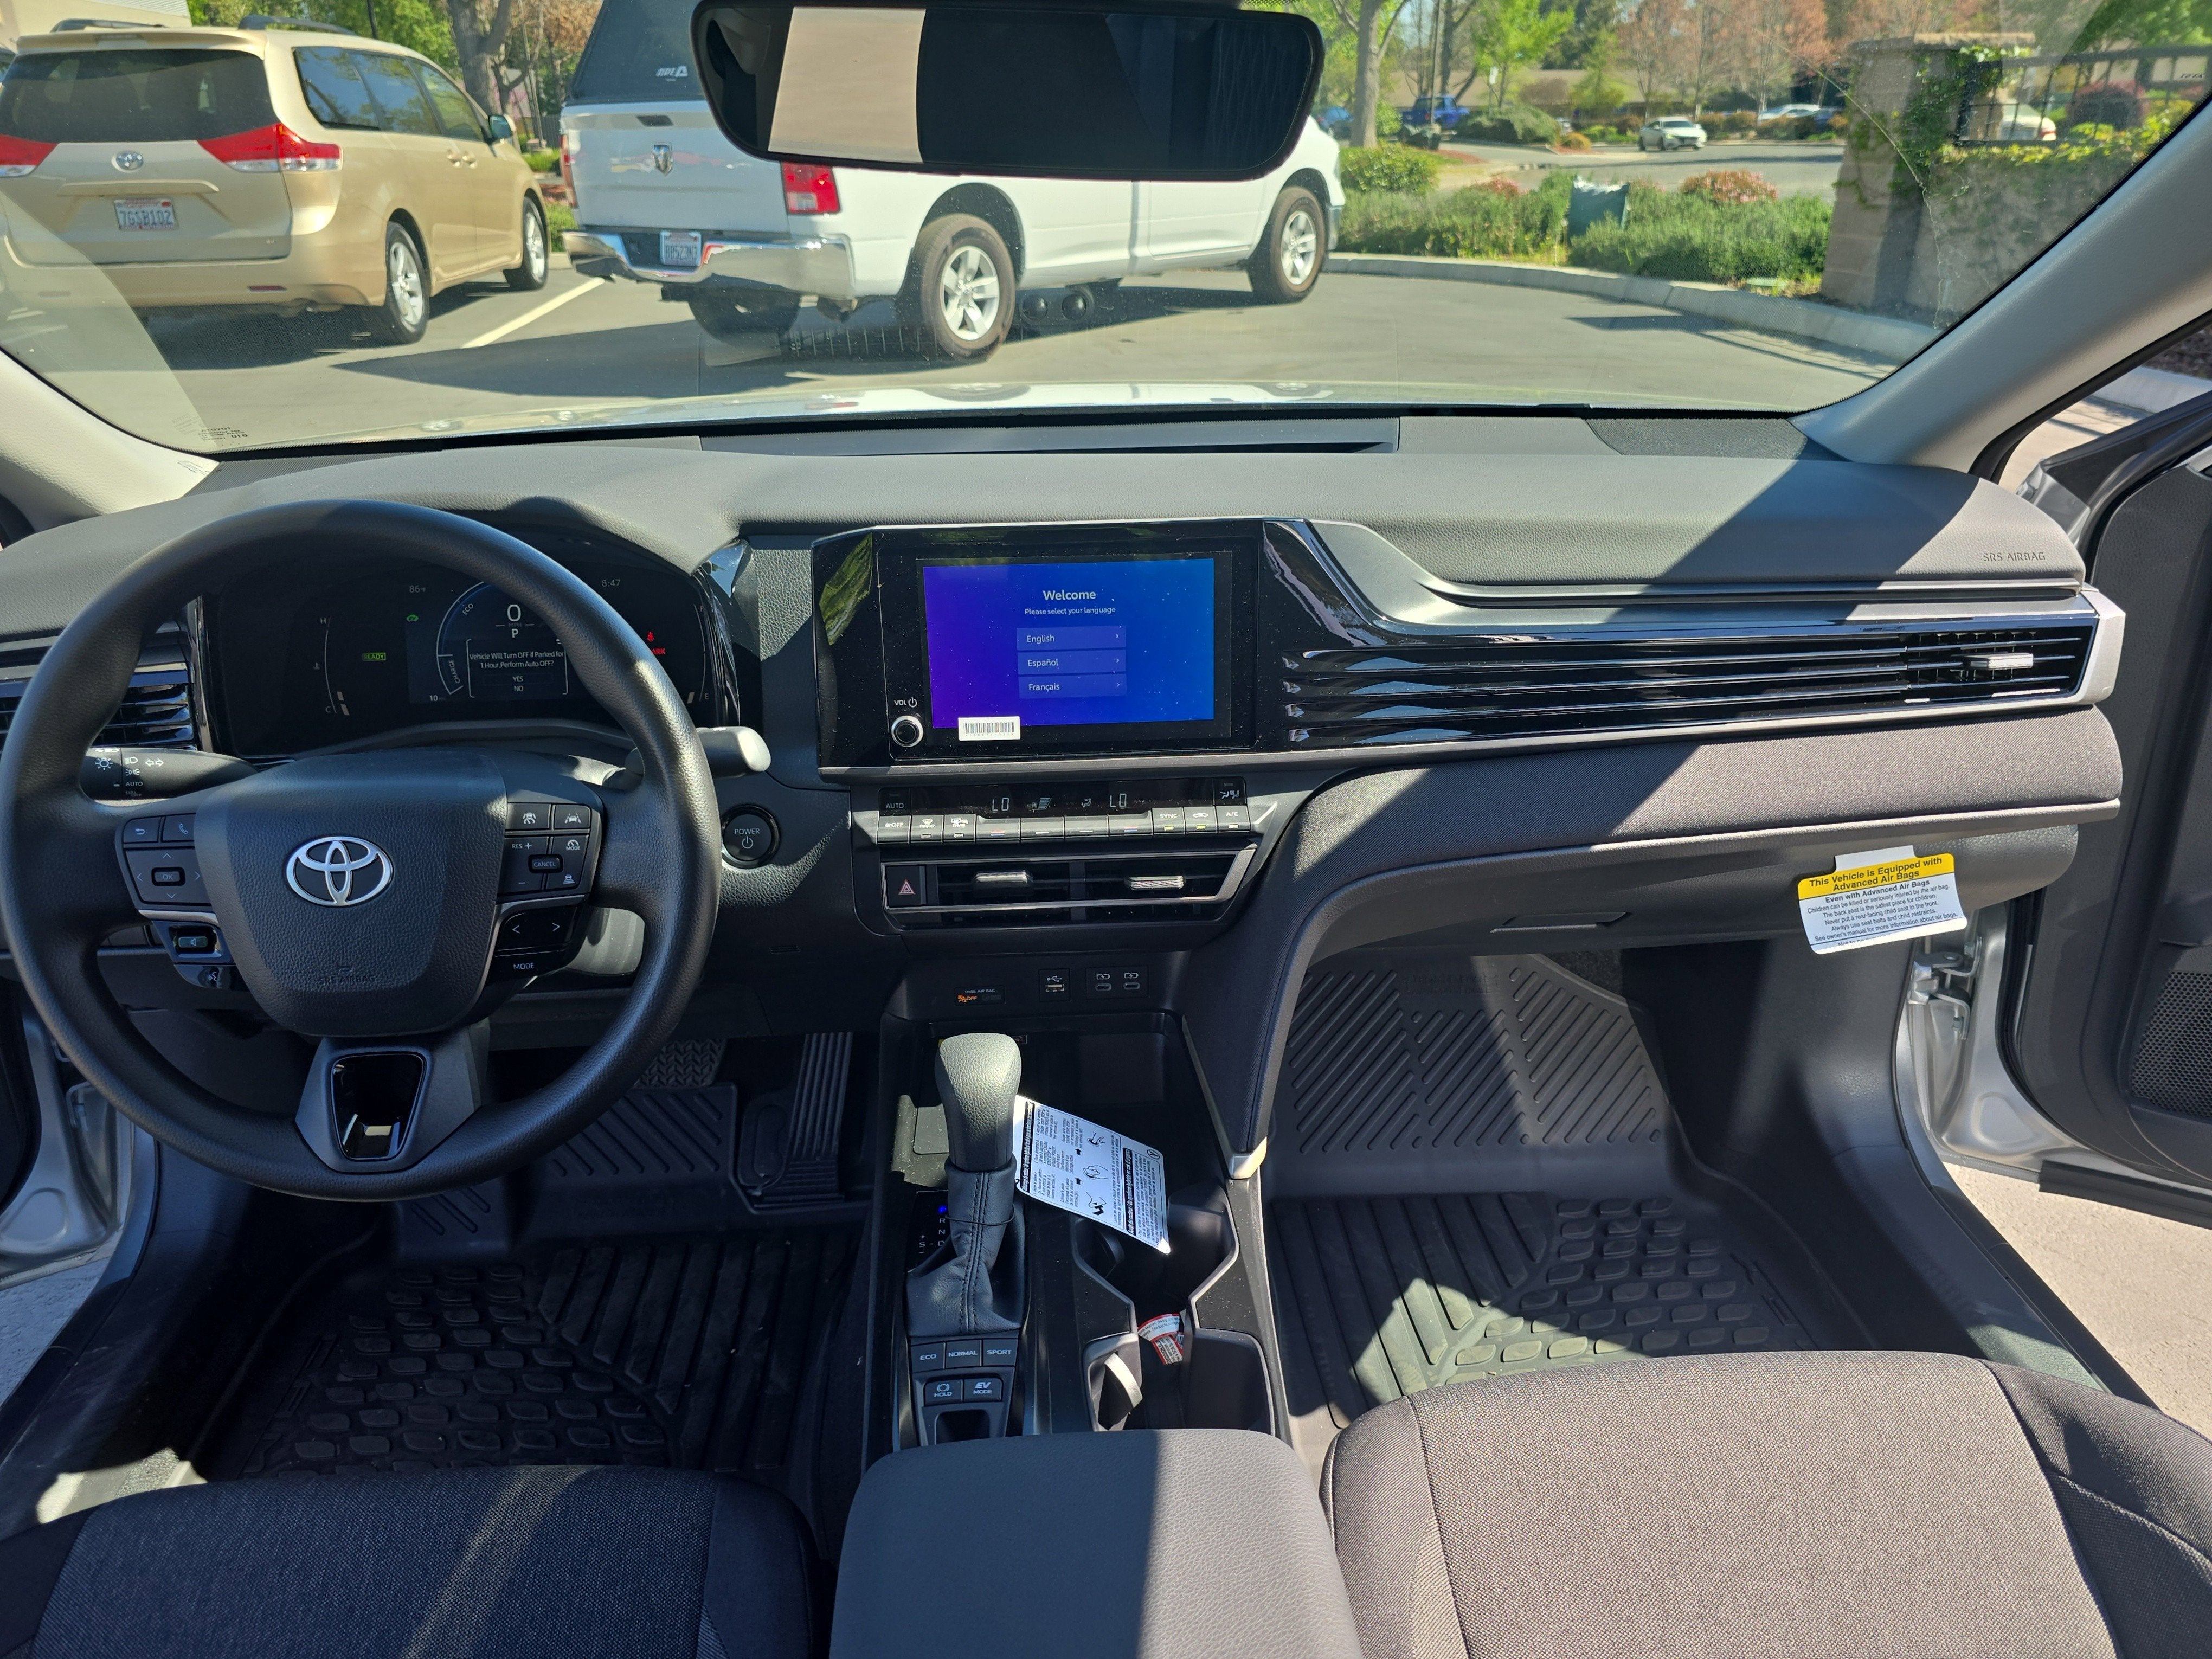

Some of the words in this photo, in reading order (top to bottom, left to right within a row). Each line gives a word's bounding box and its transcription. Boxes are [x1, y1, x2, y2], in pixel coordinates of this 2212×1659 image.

[1983, 552, 2003, 562] SRS
[2007, 552, 2046, 562] AIRBAG
[1043, 590, 1096, 601] Welcome
[462, 603, 474, 615] ECO
[512, 629, 519, 638] P
[1027, 634, 1055, 644] English
[1027, 658, 1059, 668] Español
[448, 660, 460, 684] CHARGE
[1028, 683, 1060, 692] Français
[992, 797, 1009, 812] LO
[1109, 793, 1127, 808] LO
[1809, 878, 1829, 887] This
[1832, 872, 1864, 883] Vehicle
[1878, 860, 1920, 875] Equipped
[1923, 857, 1942, 866] with
[1833, 877, 1879, 891] Advanced
[1881, 873, 1894, 883] Air
[1896, 870, 1919, 880] Bags
[1825, 895, 1843, 903] Even
[1845, 892, 1860, 900] with
[1862, 885, 1898, 897] Advanced
[1899, 883, 1909, 891] Air
[1912, 879, 1930, 888] Bags
[1808, 905, 1830, 914] Children
[1870, 893, 1893, 903] seriously
[1894, 890, 1912, 898] injured
[1915, 893, 1937, 902] children.
[1855, 910, 1883, 919] rear-facing
[1911, 908, 1937, 917] restraints.
[1827, 931, 1847, 940] owner's
[1848, 927, 1867, 936] manual
[1890, 919, 1919, 928] information
